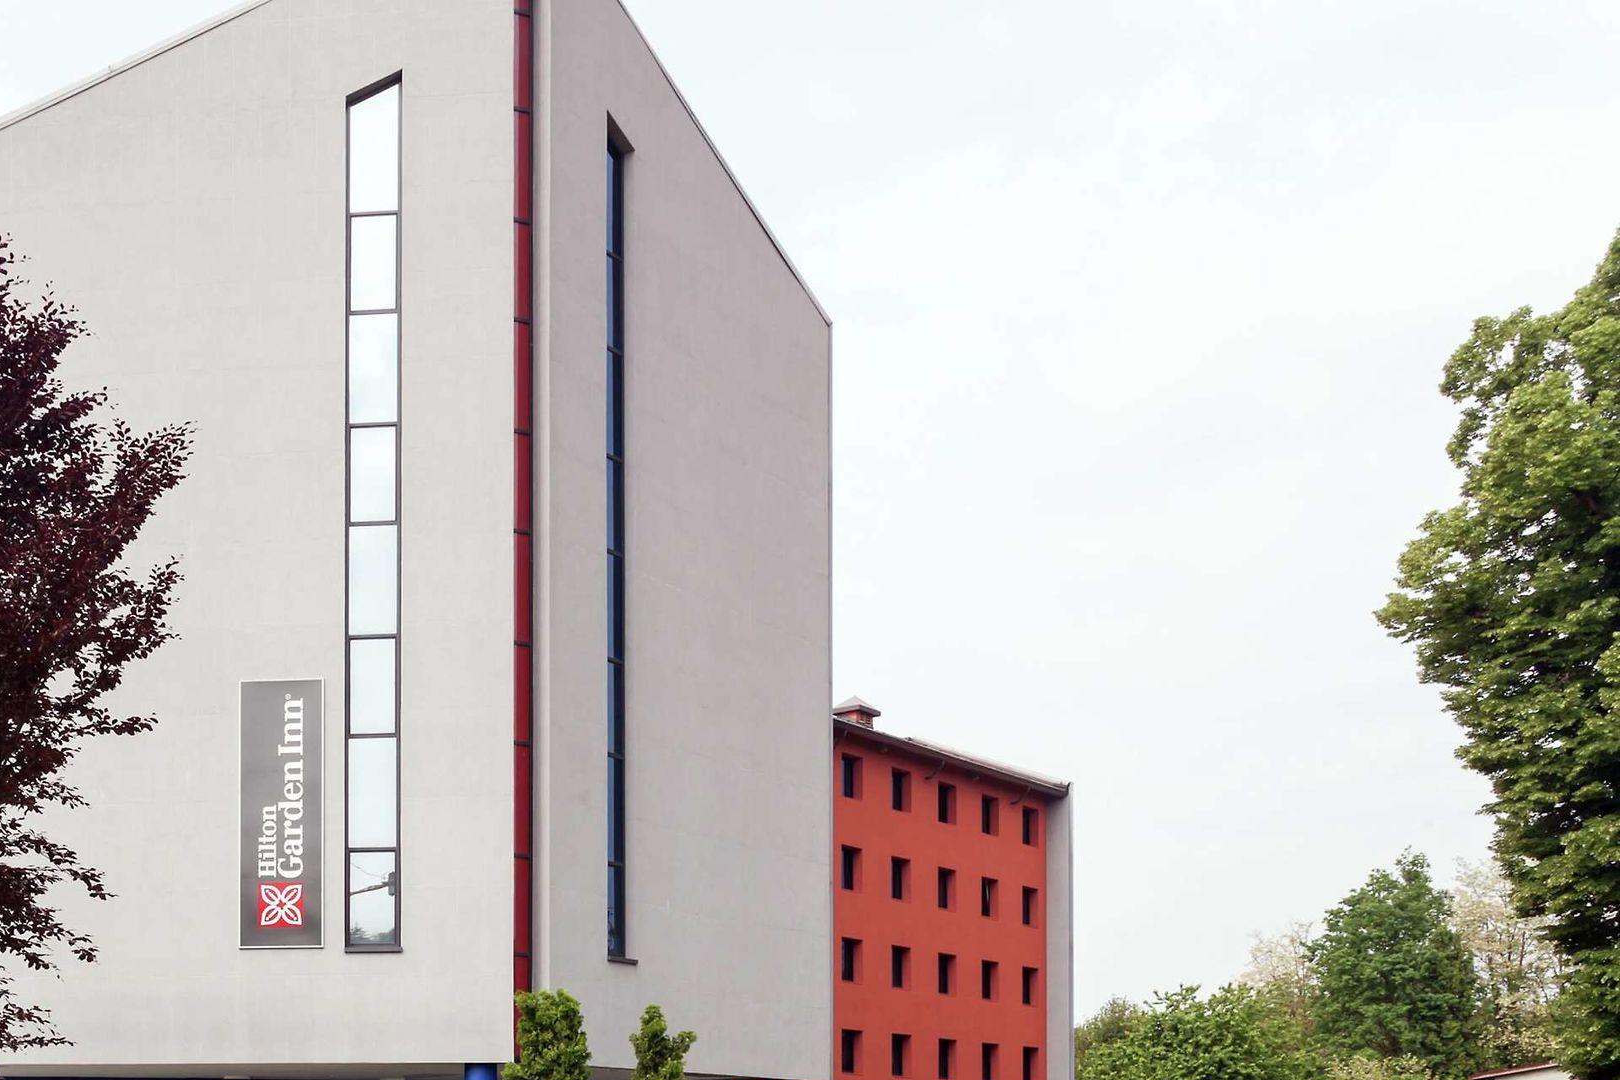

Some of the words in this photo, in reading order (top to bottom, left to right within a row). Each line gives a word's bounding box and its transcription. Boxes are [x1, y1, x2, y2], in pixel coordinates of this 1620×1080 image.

[278, 697, 304, 756] Inn
[258, 804, 277, 878] Hilton
[277, 759, 304, 879] Garden
